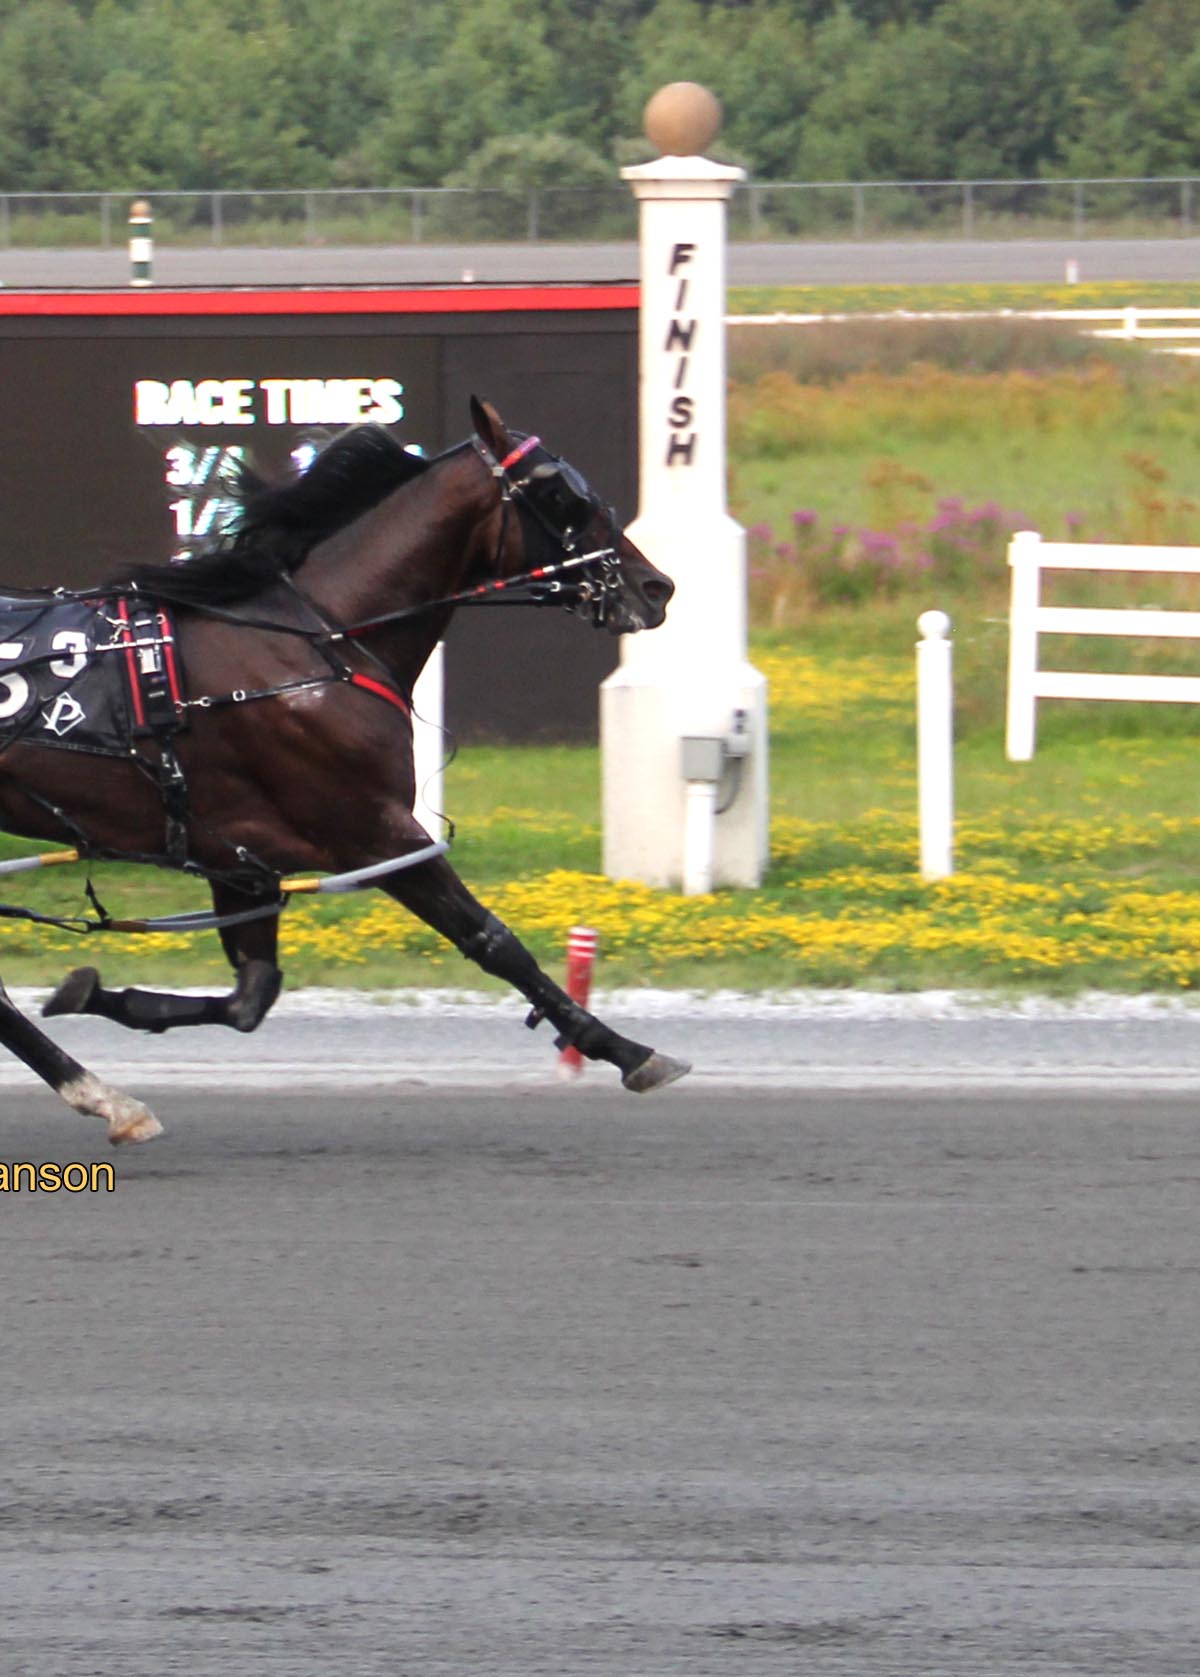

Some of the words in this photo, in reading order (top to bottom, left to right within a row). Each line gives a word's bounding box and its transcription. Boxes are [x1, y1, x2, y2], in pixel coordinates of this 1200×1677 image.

[665, 243, 697, 466] FINISH
[134, 379, 255, 425] RACE
[259, 378, 404, 424] TIMES
[49, 630, 89, 678] 3
